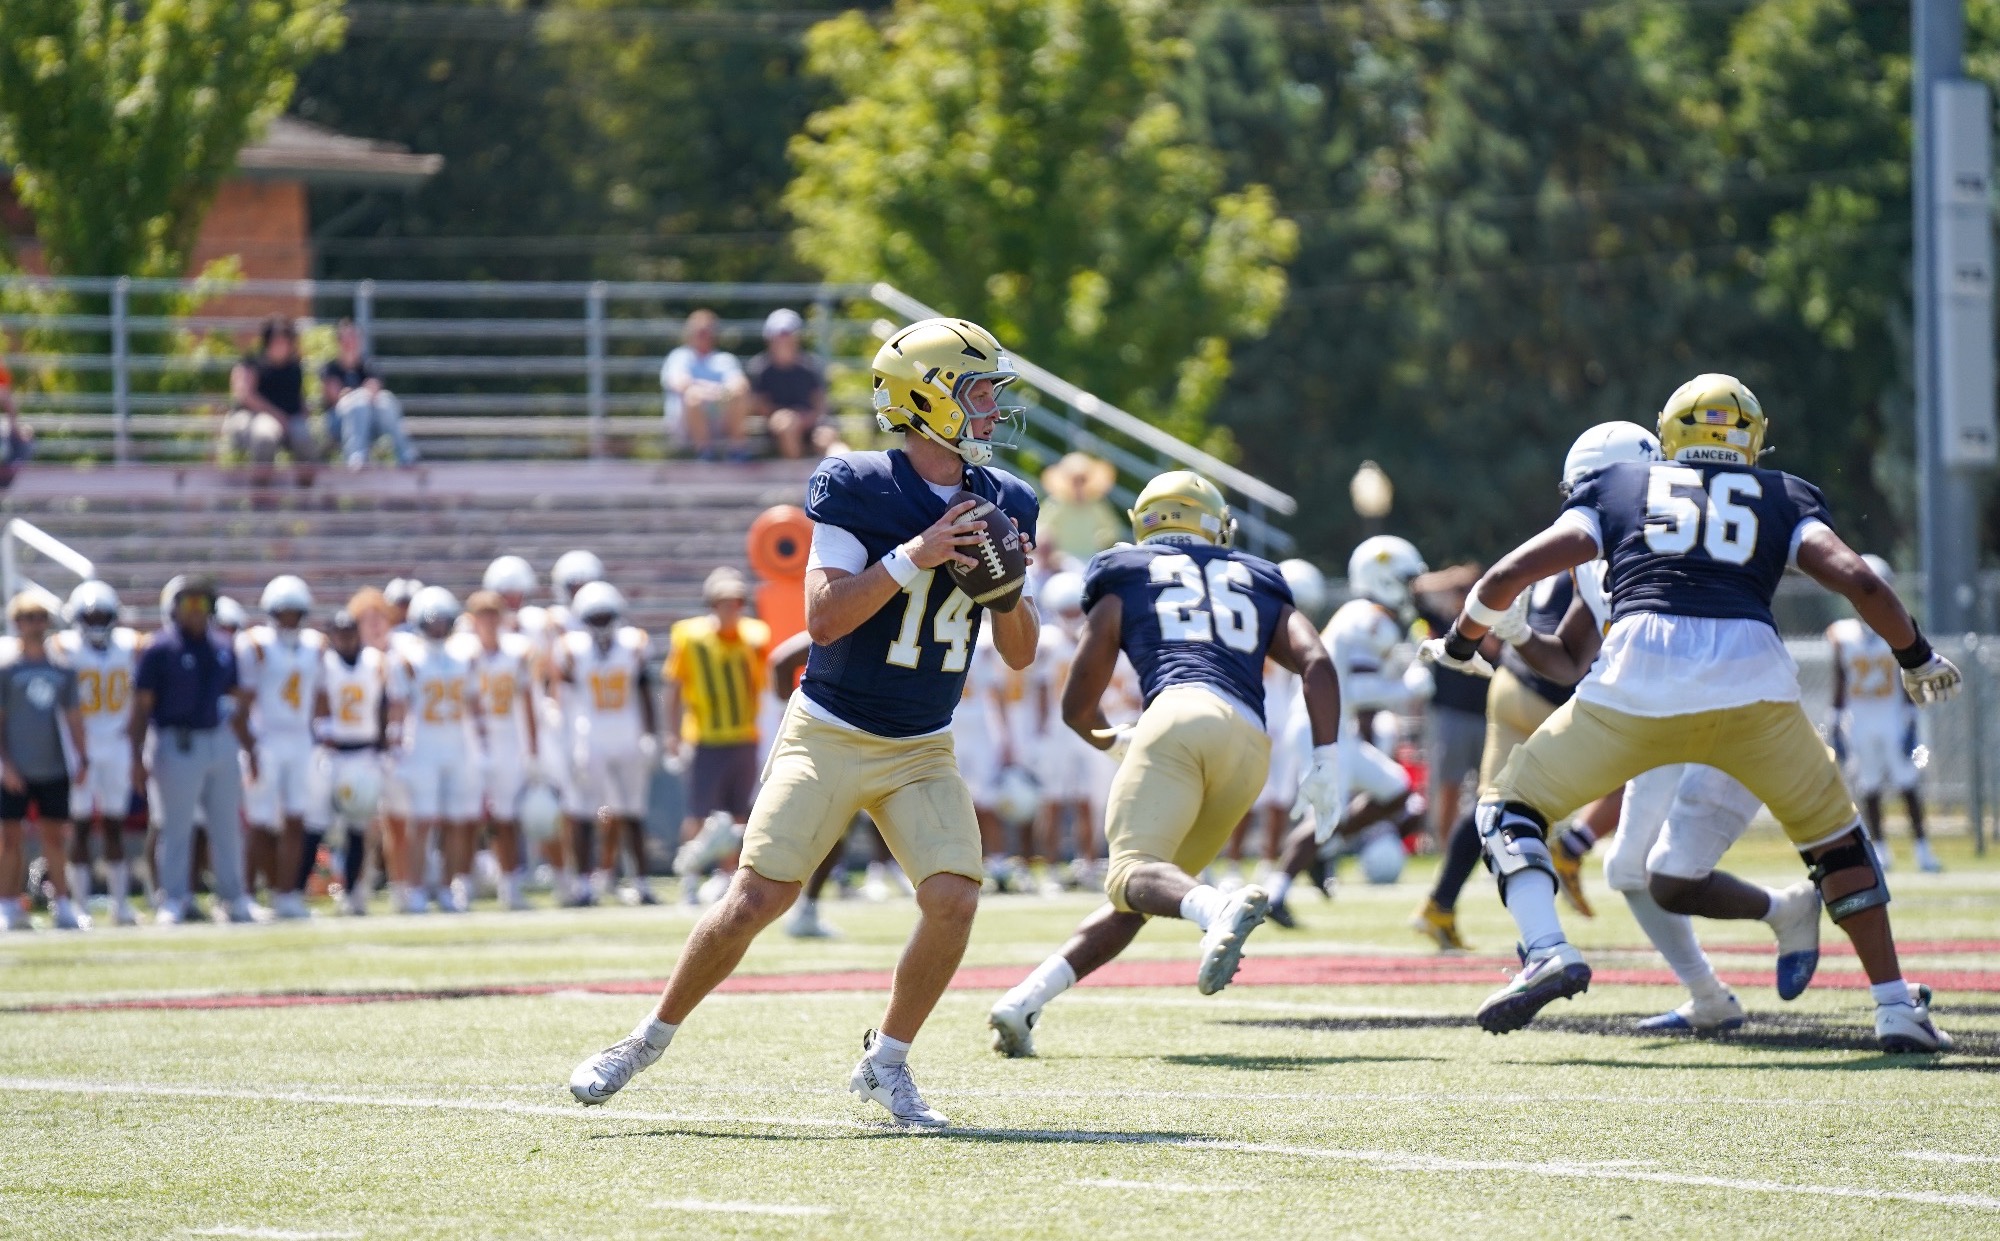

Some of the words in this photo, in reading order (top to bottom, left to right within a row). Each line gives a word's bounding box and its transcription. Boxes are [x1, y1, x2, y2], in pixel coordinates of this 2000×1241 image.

[1686, 449, 1738, 462] LANCERS
[1644, 465, 1762, 566] 56
[886, 568, 975, 672] 14
[1149, 554, 1259, 653] 26
[79, 669, 131, 714] 30
[280, 672, 302, 710] 4
[338, 685, 365, 722] 2
